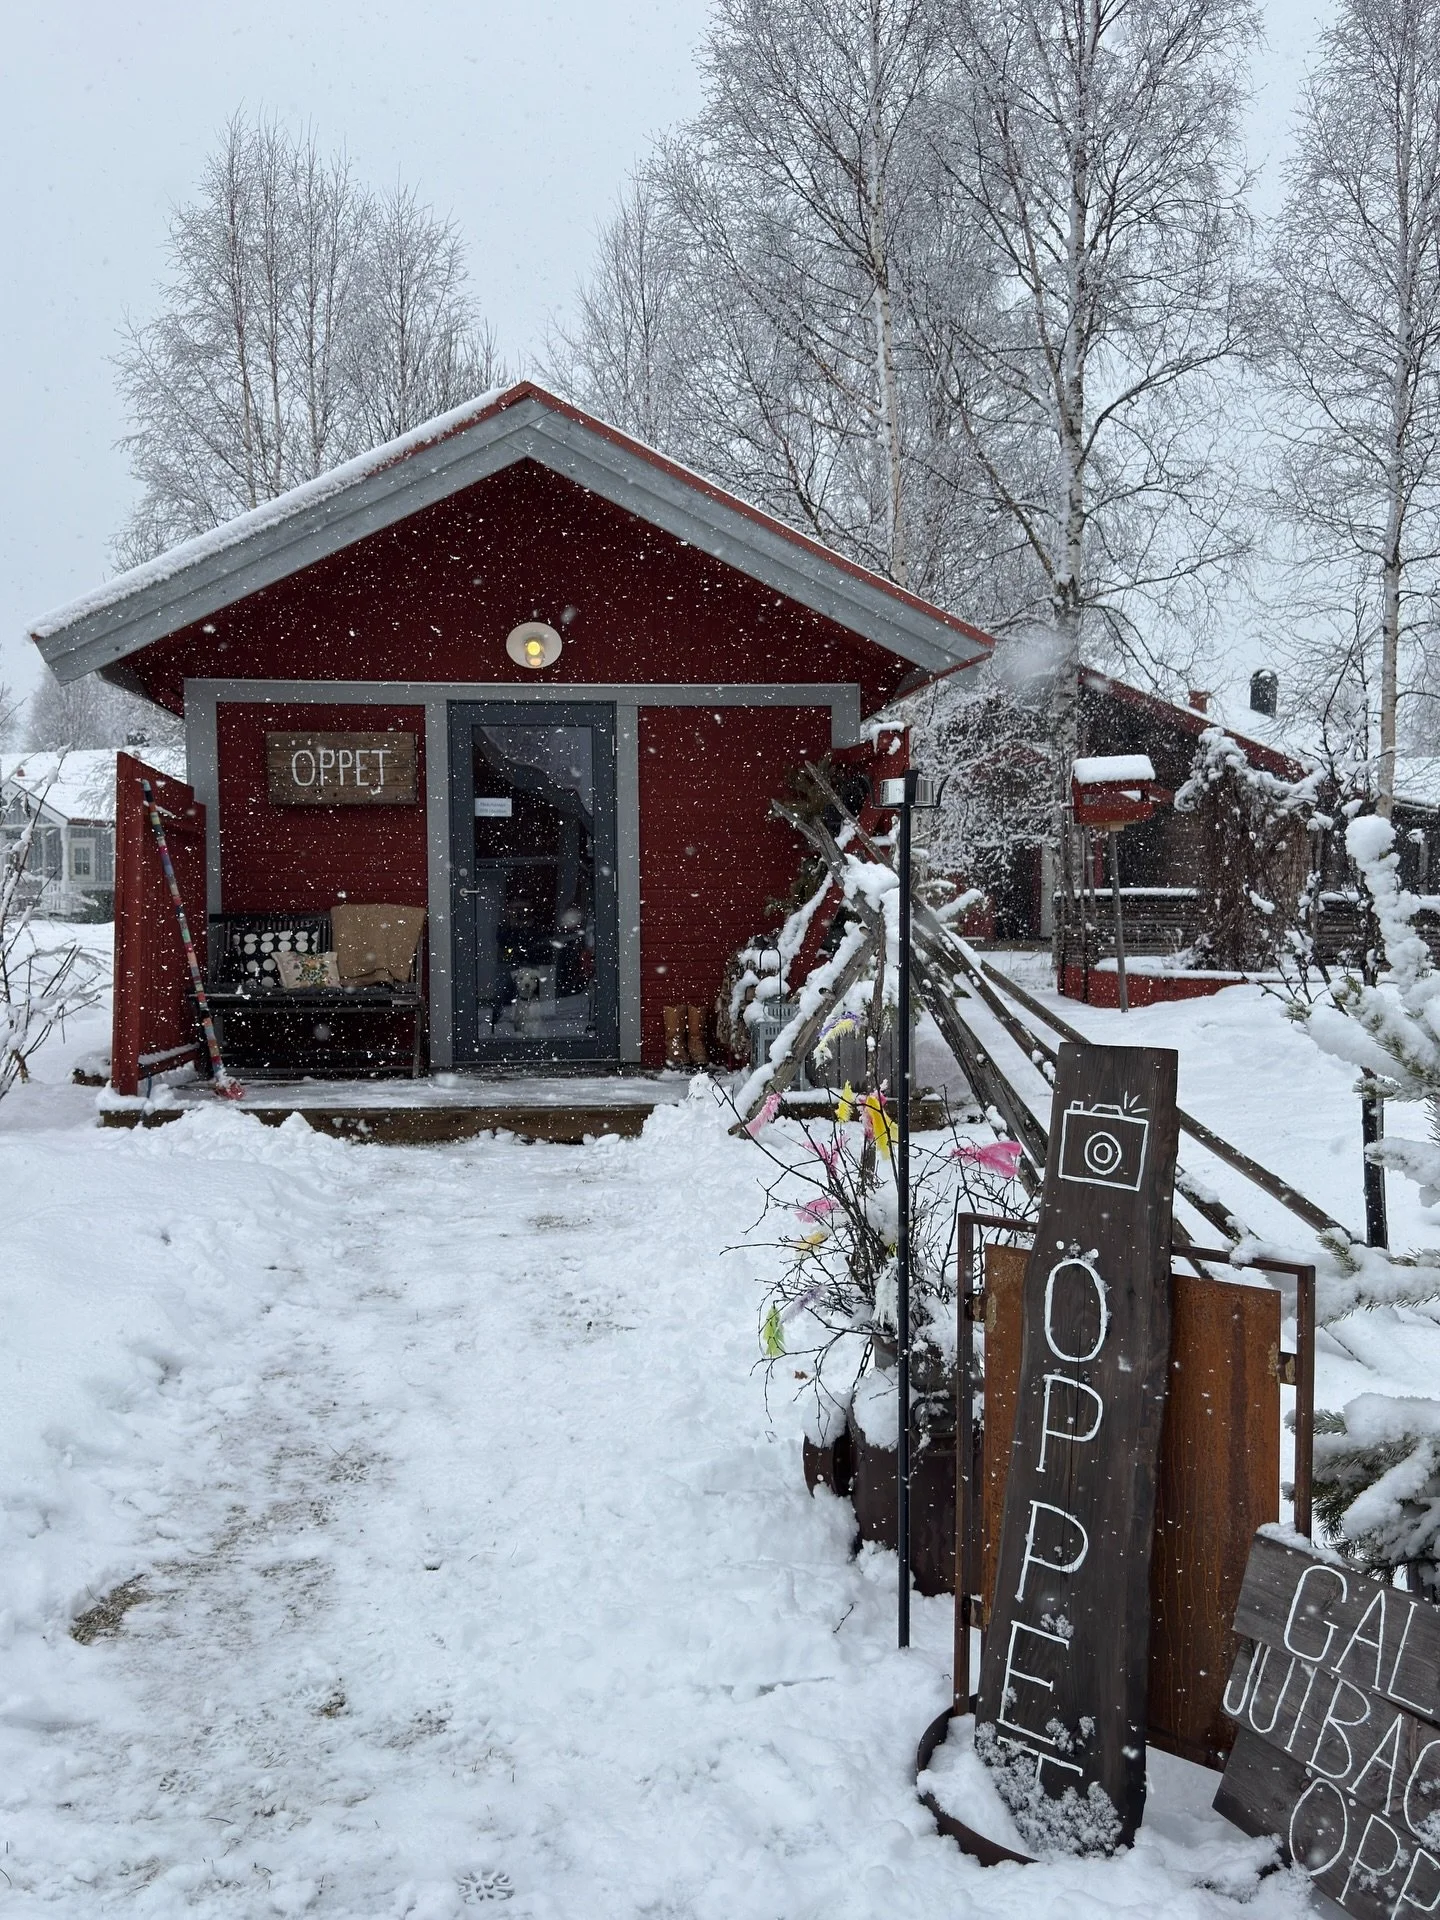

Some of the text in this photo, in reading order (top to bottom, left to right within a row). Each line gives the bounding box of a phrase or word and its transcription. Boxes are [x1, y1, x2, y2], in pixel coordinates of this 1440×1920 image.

[291, 739, 392, 787] ÖPPET
[996, 1240, 1108, 1786] ÖPPET
[1283, 1564, 1435, 1715] GAL
